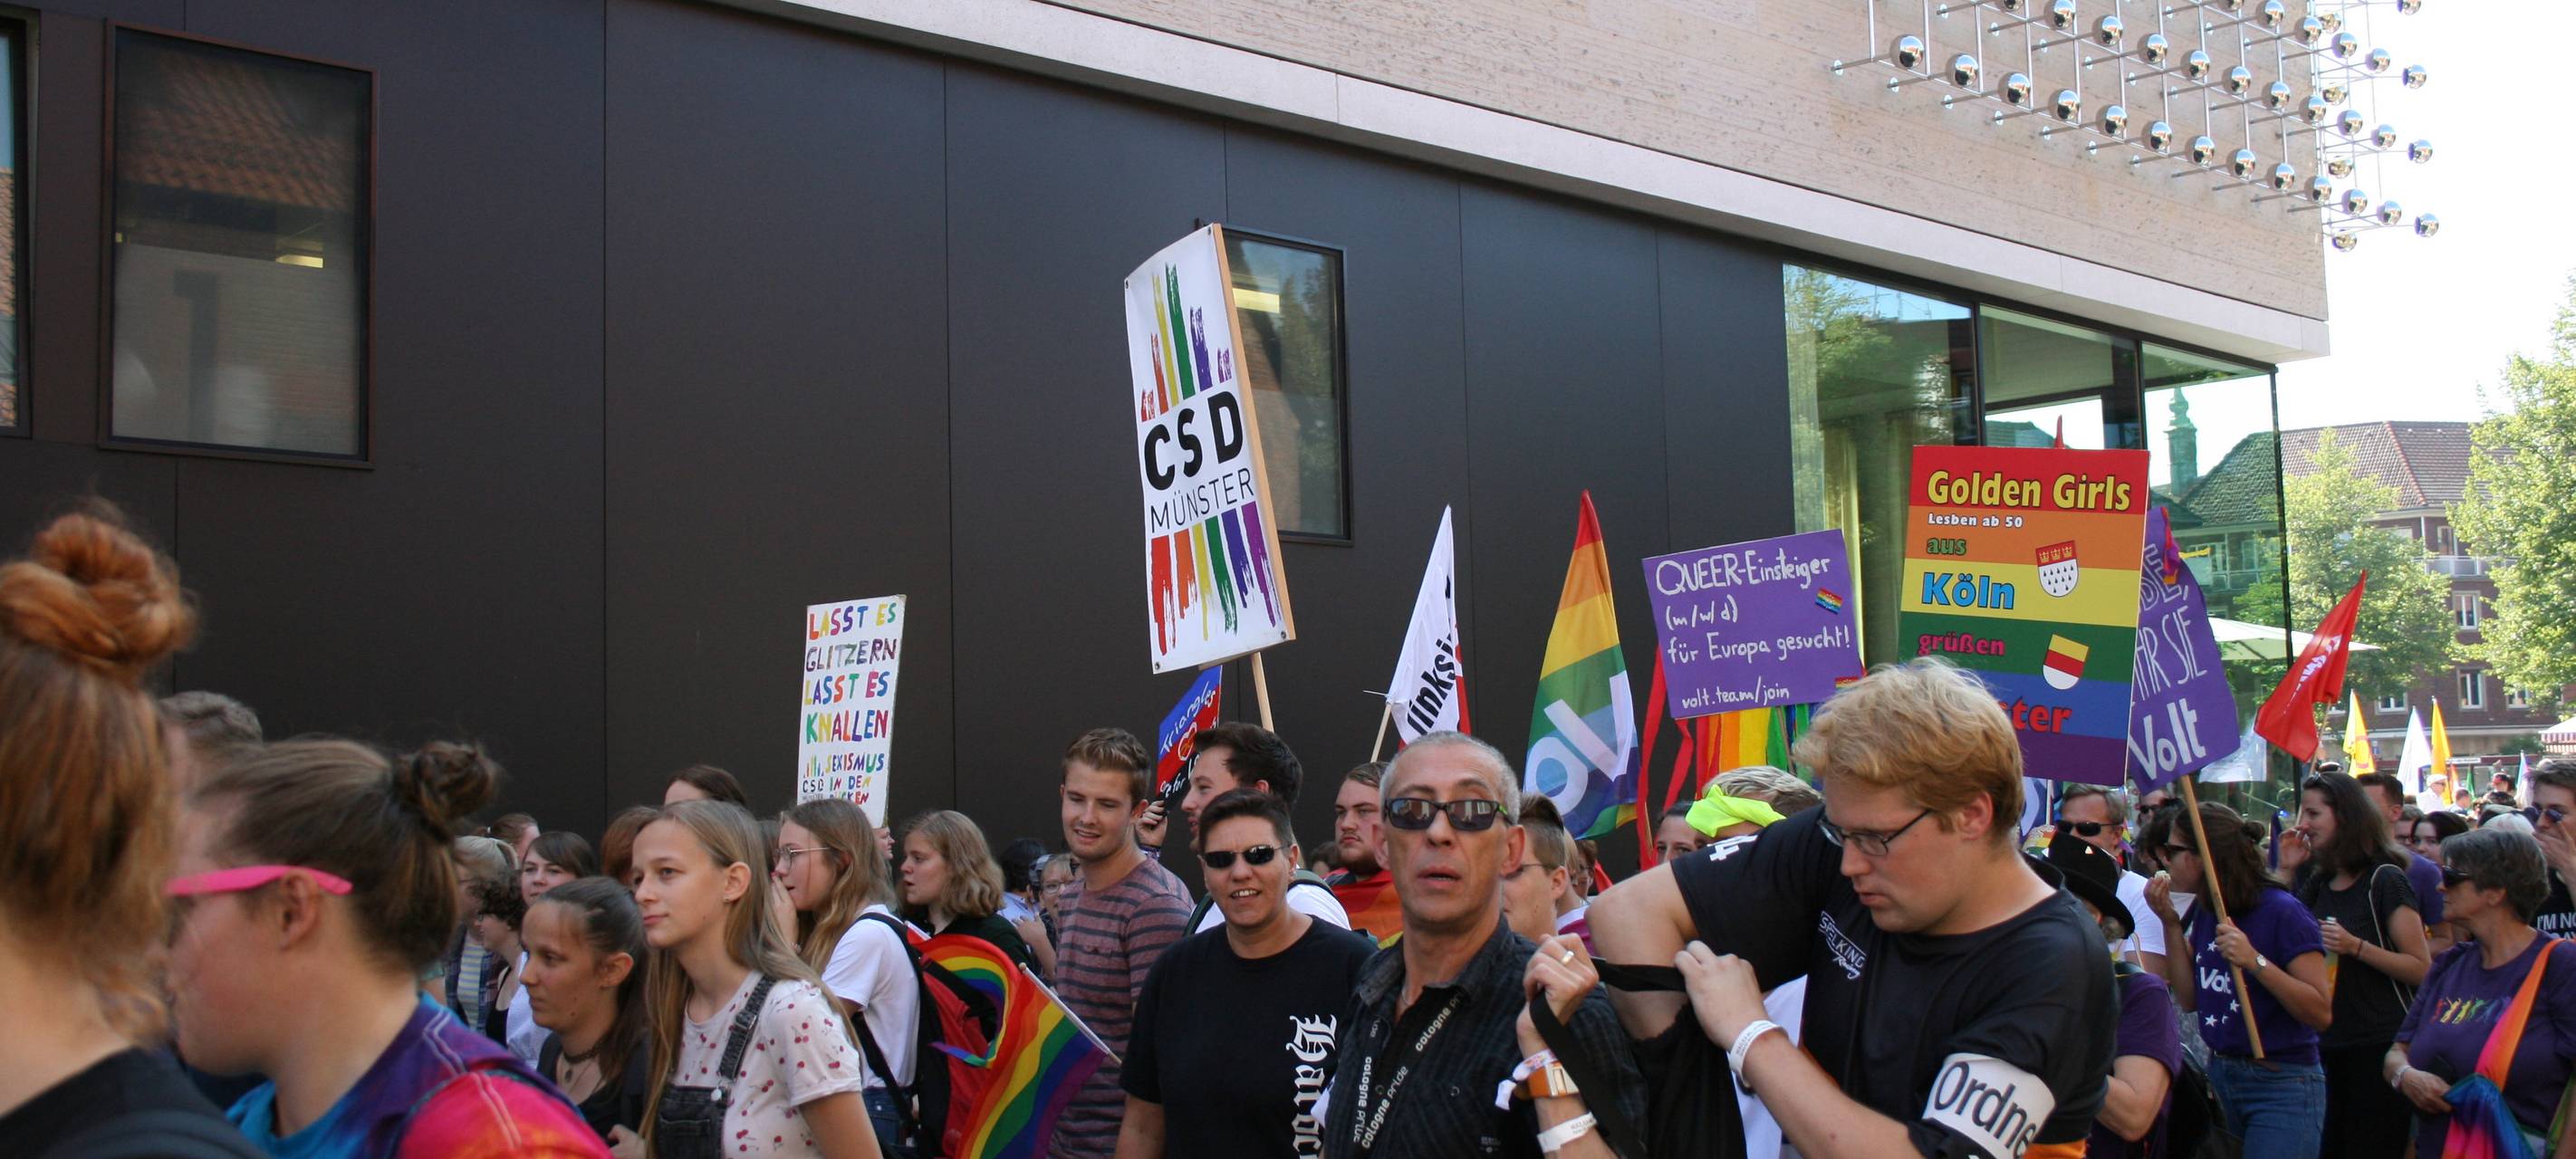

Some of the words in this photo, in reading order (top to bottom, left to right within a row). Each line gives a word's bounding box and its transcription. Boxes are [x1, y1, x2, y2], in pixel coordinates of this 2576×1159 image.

[1144, 391, 1244, 491] CSD
[1150, 467, 1254, 533] MÜNSTER
[1927, 469, 2042, 508] Golden
[2052, 473, 2131, 512] Girls
[1927, 512, 1977, 527] Lesben
[1982, 515, 2000, 527] ab
[2004, 516, 2023, 528] 50
[1927, 537, 1967, 556] aus
[1656, 548, 1831, 595] QUEER-Einsteiger
[1920, 571, 2015, 610] Köln
[809, 606, 869, 640] LASST
[876, 602, 897, 627] ES
[806, 638, 897, 673] GLITZERN
[1668, 637, 1698, 664] für
[1706, 632, 1771, 664] Europa
[1777, 625, 1850, 660] gesucht!
[1918, 631, 2006, 657] grüßen
[804, 673, 860, 705] LASST
[865, 671, 890, 698] ES
[1681, 675, 1790, 709] volt.team/join
[806, 710, 889, 744] KNALLEN
[2129, 697, 2206, 781] Volt
[825, 752, 885, 773] SEXISMUS
[803, 779, 823, 792] CSD
[830, 777, 841, 791] IN
[848, 775, 871, 790] DEN
[2537, 913, 2557, 930] I'M
[1416, 1007, 1451, 1052] cologne
[1359, 1057, 1372, 1107] cologne
[1362, 1098, 1391, 1149] cologne
